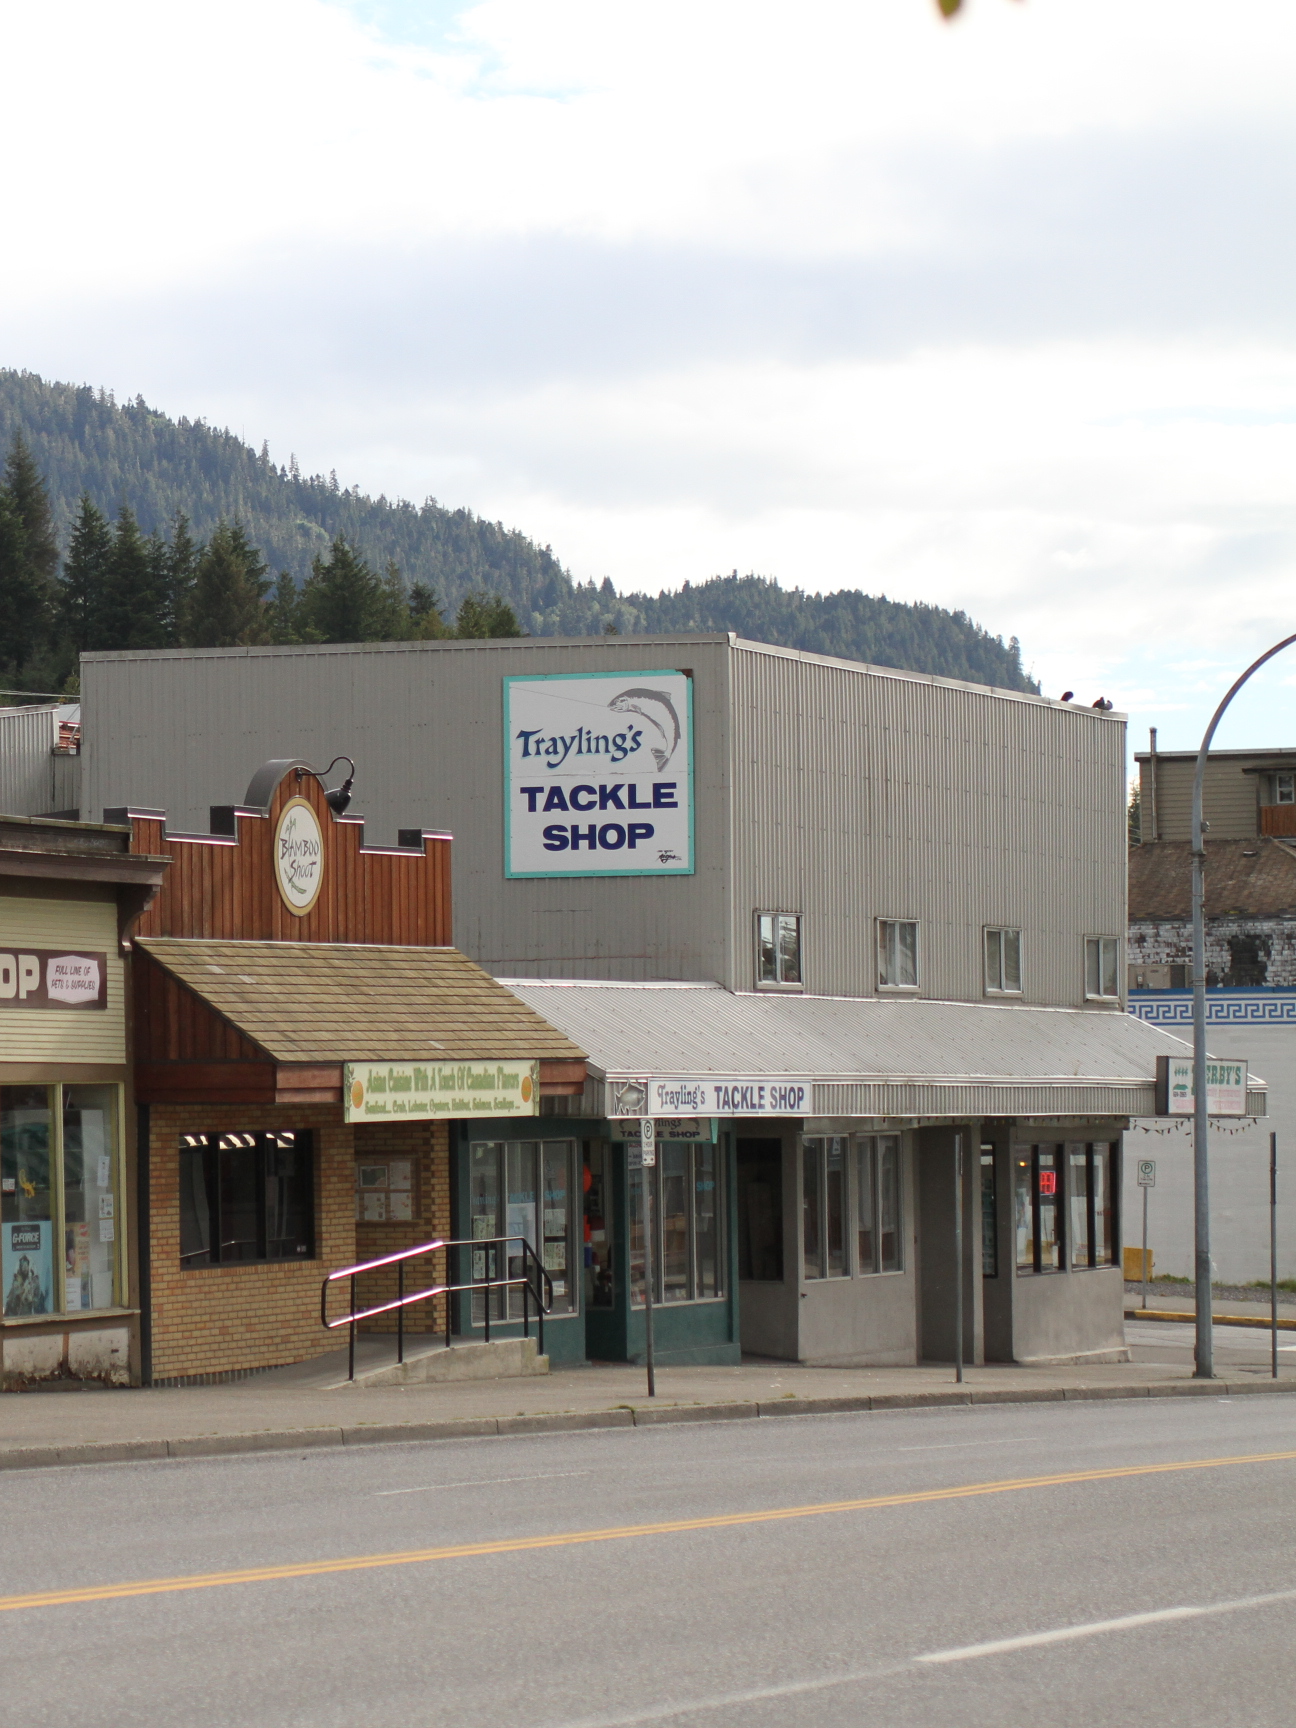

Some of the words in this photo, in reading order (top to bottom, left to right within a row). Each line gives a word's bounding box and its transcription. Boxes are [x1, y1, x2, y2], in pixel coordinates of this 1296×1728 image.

[516, 724, 643, 769] Trayling's
[520, 782, 678, 812] TACKLE
[542, 823, 655, 851] SHOP
[280, 839, 319, 859] BAMBOO
[55, 965, 68, 975] FULL
[70, 966, 82, 976] LINE
[83, 966, 91, 976] OF
[51, 979, 64, 989] PETS
[71, 980, 96, 991] SUPPLIES
[430, 1067, 436, 1091] A
[657, 1084, 705, 1110] Trayling's
[714, 1086, 765, 1110] TACKLE
[770, 1086, 804, 1110] SHOP
[646, 1125, 650, 1136] P
[13, 1232, 39, 1244] G-FORCE
